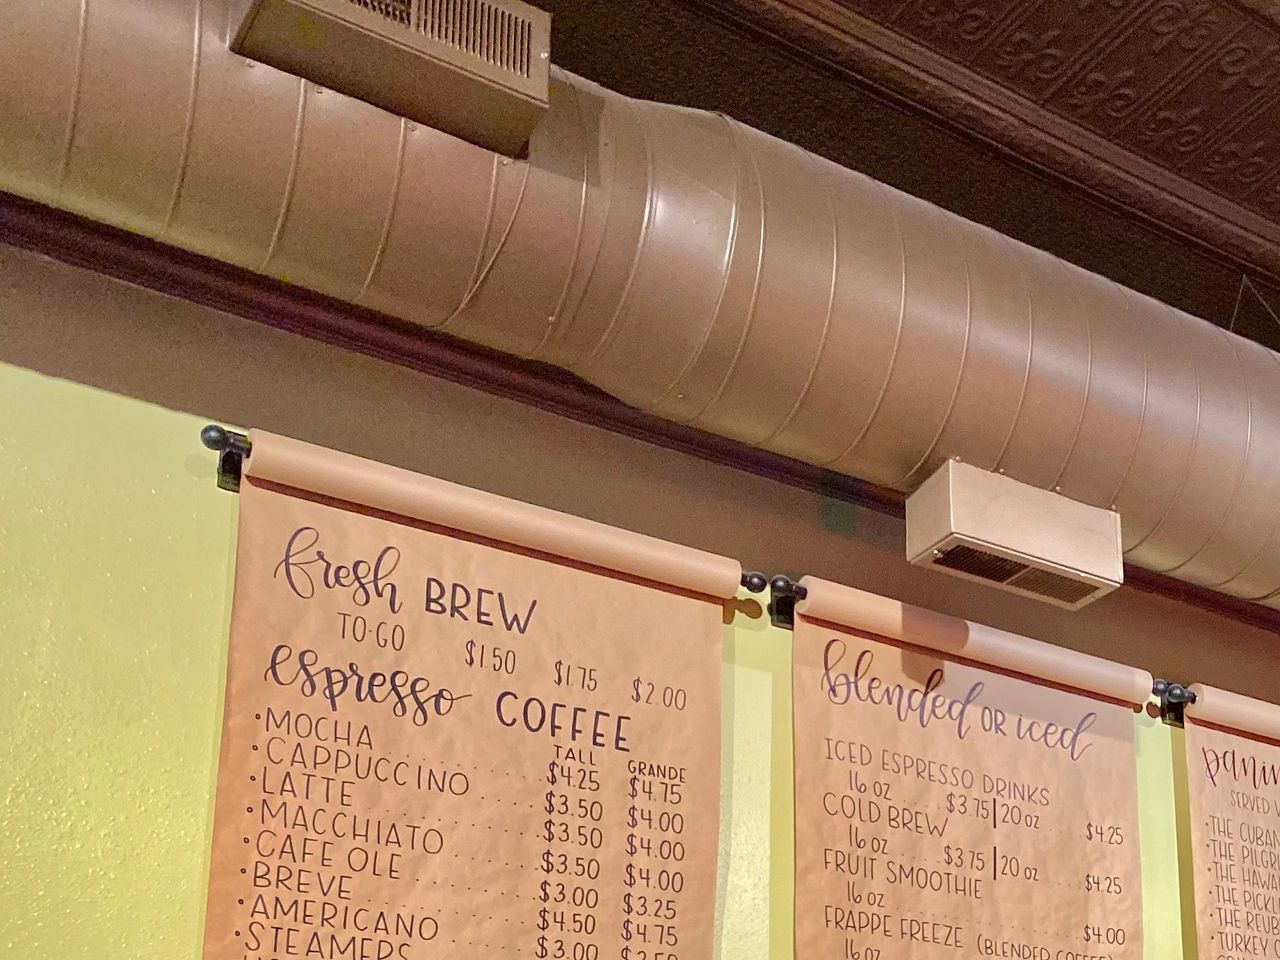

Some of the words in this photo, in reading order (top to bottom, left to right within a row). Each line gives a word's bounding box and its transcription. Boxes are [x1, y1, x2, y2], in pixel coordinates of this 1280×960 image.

[274, 527, 404, 613] fresh
[425, 577, 537, 634] BREW
[338, 612, 406, 652] TO-GO
[465, 639, 516, 673] $1.50
[554, 660, 598, 692] $1.75
[631, 677, 687, 711] $2.00
[264, 644, 473, 726] espresso
[496, 691, 631, 752] COFFEE
[821, 639, 984, 739] blended
[982, 707, 1006, 737] OR
[1016, 712, 1097, 760] iced
[265, 707, 373, 749] MOCHA
[546, 763, 600, 792] $4.25
[628, 775, 682, 804] $4.75
[267, 737, 469, 795] CAPPUCCINO
[545, 793, 603, 821] $3.50
[628, 806, 684, 833] $4.00
[553, 745, 597, 766] TALL
[628, 760, 687, 784] GRANDE
[825, 738, 872, 765] ICED
[882, 749, 973, 788] ESPRESSO
[983, 773, 1049, 806] DRINKS
[261, 799, 444, 854] MACCHIATO
[262, 767, 355, 806] LATTE
[544, 821, 603, 849] $3.50
[626, 834, 685, 861] $4.00
[823, 792, 880, 822] COLD
[889, 807, 948, 837] BREW
[1210, 816, 1232, 838] THE
[253, 863, 352, 899] BREVE
[257, 831, 333, 866] CAFE
[347, 847, 401, 879] OLE
[539, 881, 599, 908] $3.00
[622, 893, 677, 919] $3.25
[824, 849, 876, 879] FRUIT
[887, 861, 982, 899] SMOOTHIE
[250, 895, 439, 940] AMERICANO
[825, 906, 892, 937] FRAPPE
[900, 919, 962, 948] FREEZE
[977, 934, 1050, 960] (BLENDED
[1218, 931, 1268, 955] TURKEY
